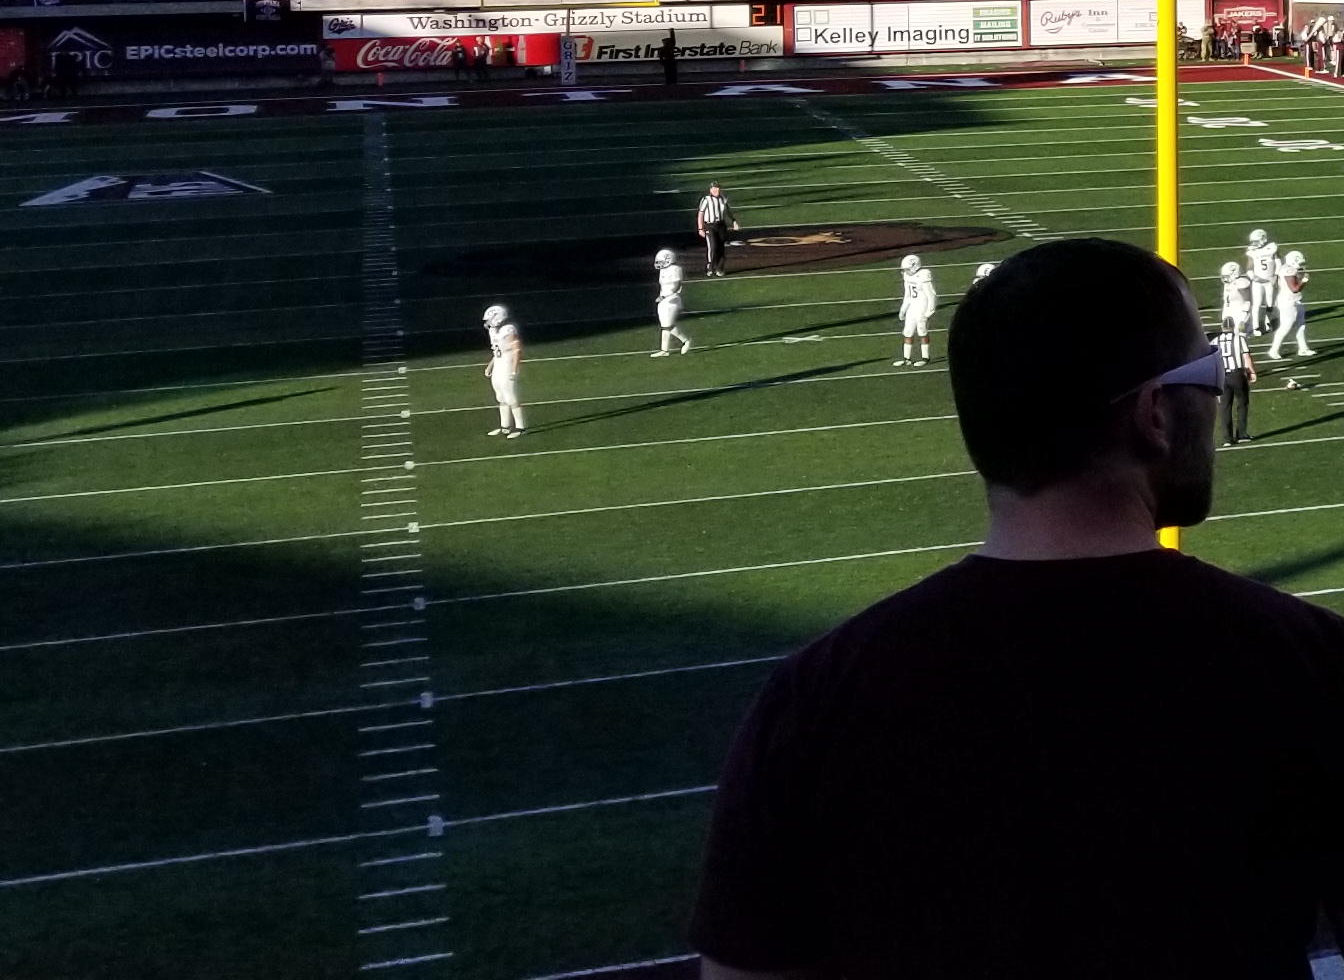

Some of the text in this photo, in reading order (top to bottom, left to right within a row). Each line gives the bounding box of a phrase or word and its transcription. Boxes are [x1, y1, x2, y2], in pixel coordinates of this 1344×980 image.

[621, 9, 708, 25] Stadium
[752, 5, 781, 25] 21
[1088, 9, 1109, 17] Inn
[1227, 10, 1263, 18] JAKERS
[814, 25, 970, 48] Kelley Imaging
[356, 36, 457, 69] Coca-Cola
[596, 40, 778, 60] First Inerstate Bank
